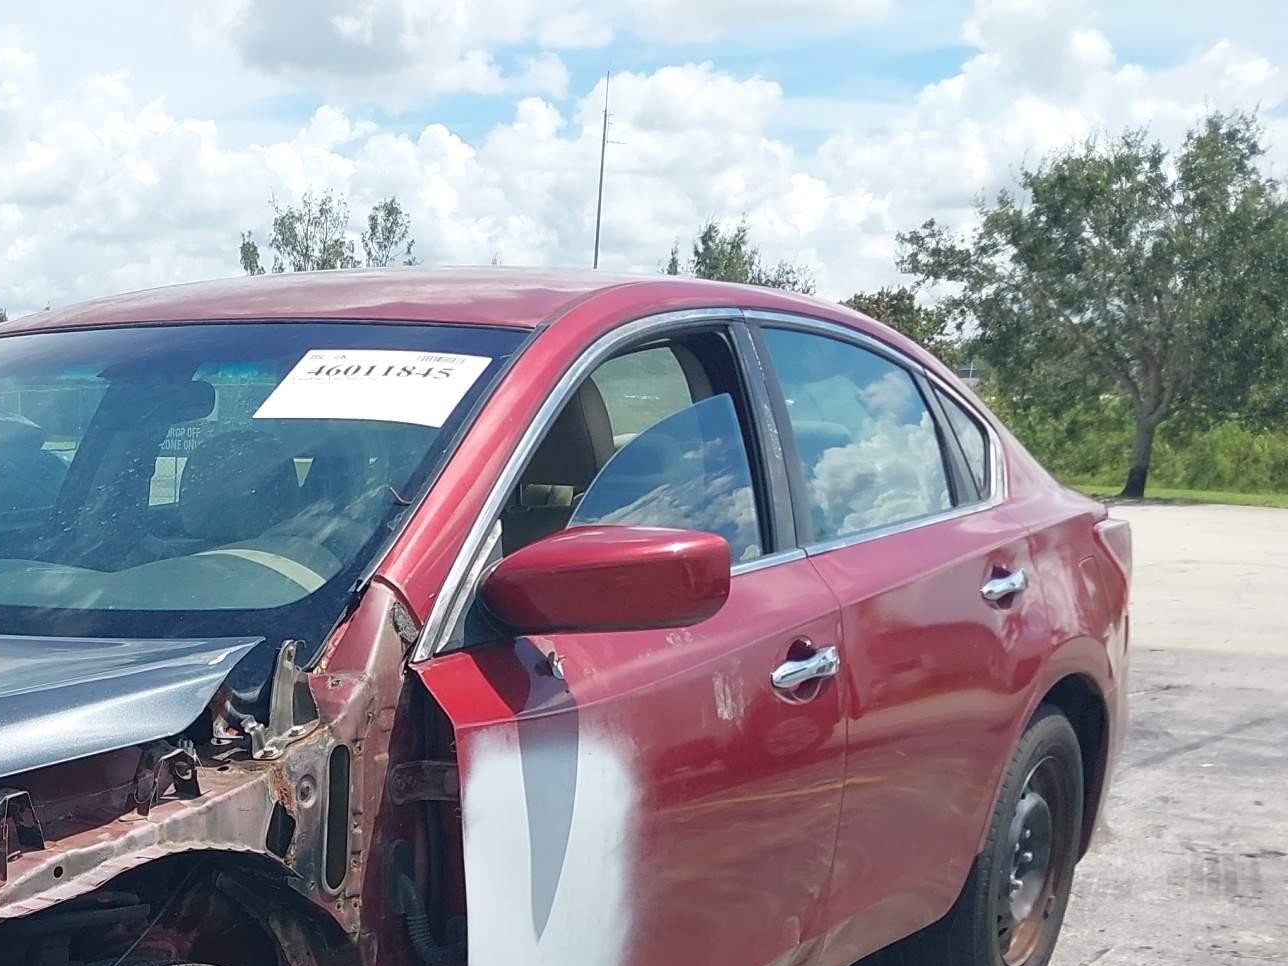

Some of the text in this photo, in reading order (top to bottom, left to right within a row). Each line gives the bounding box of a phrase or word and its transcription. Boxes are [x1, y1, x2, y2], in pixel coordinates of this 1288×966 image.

[306, 365, 455, 380] 46011845
[187, 427, 201, 438] OFF
[160, 439, 182, 450] ZONE
